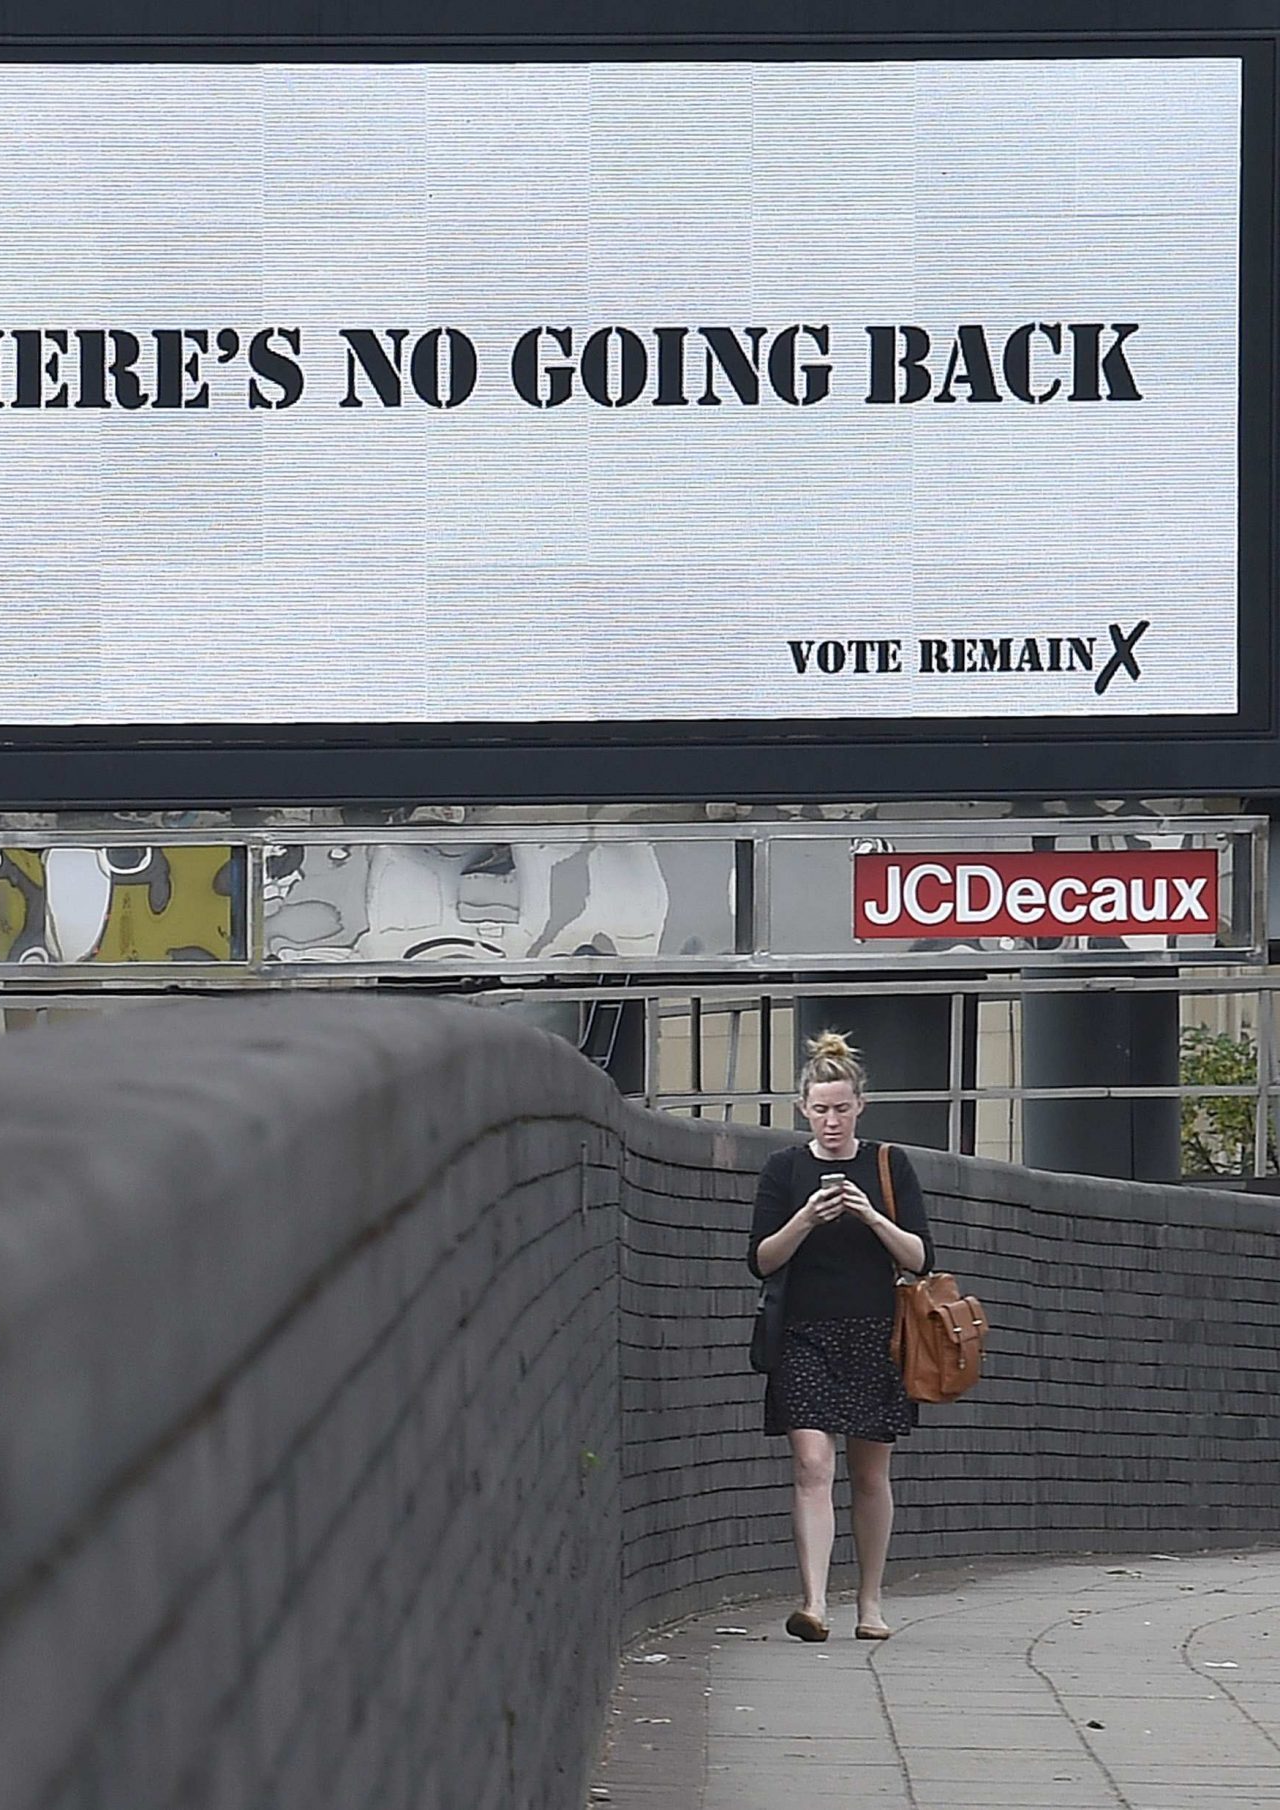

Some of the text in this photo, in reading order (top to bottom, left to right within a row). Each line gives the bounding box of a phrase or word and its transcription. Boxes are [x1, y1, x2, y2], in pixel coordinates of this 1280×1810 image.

[338, 326, 478, 409] NO
[511, 324, 832, 409] GOING
[864, 321, 1143, 406] BACK
[787, 639, 902, 674] VOTE
[918, 637, 1097, 673] REMAIN
[863, 863, 1210, 925] JCDecaux
